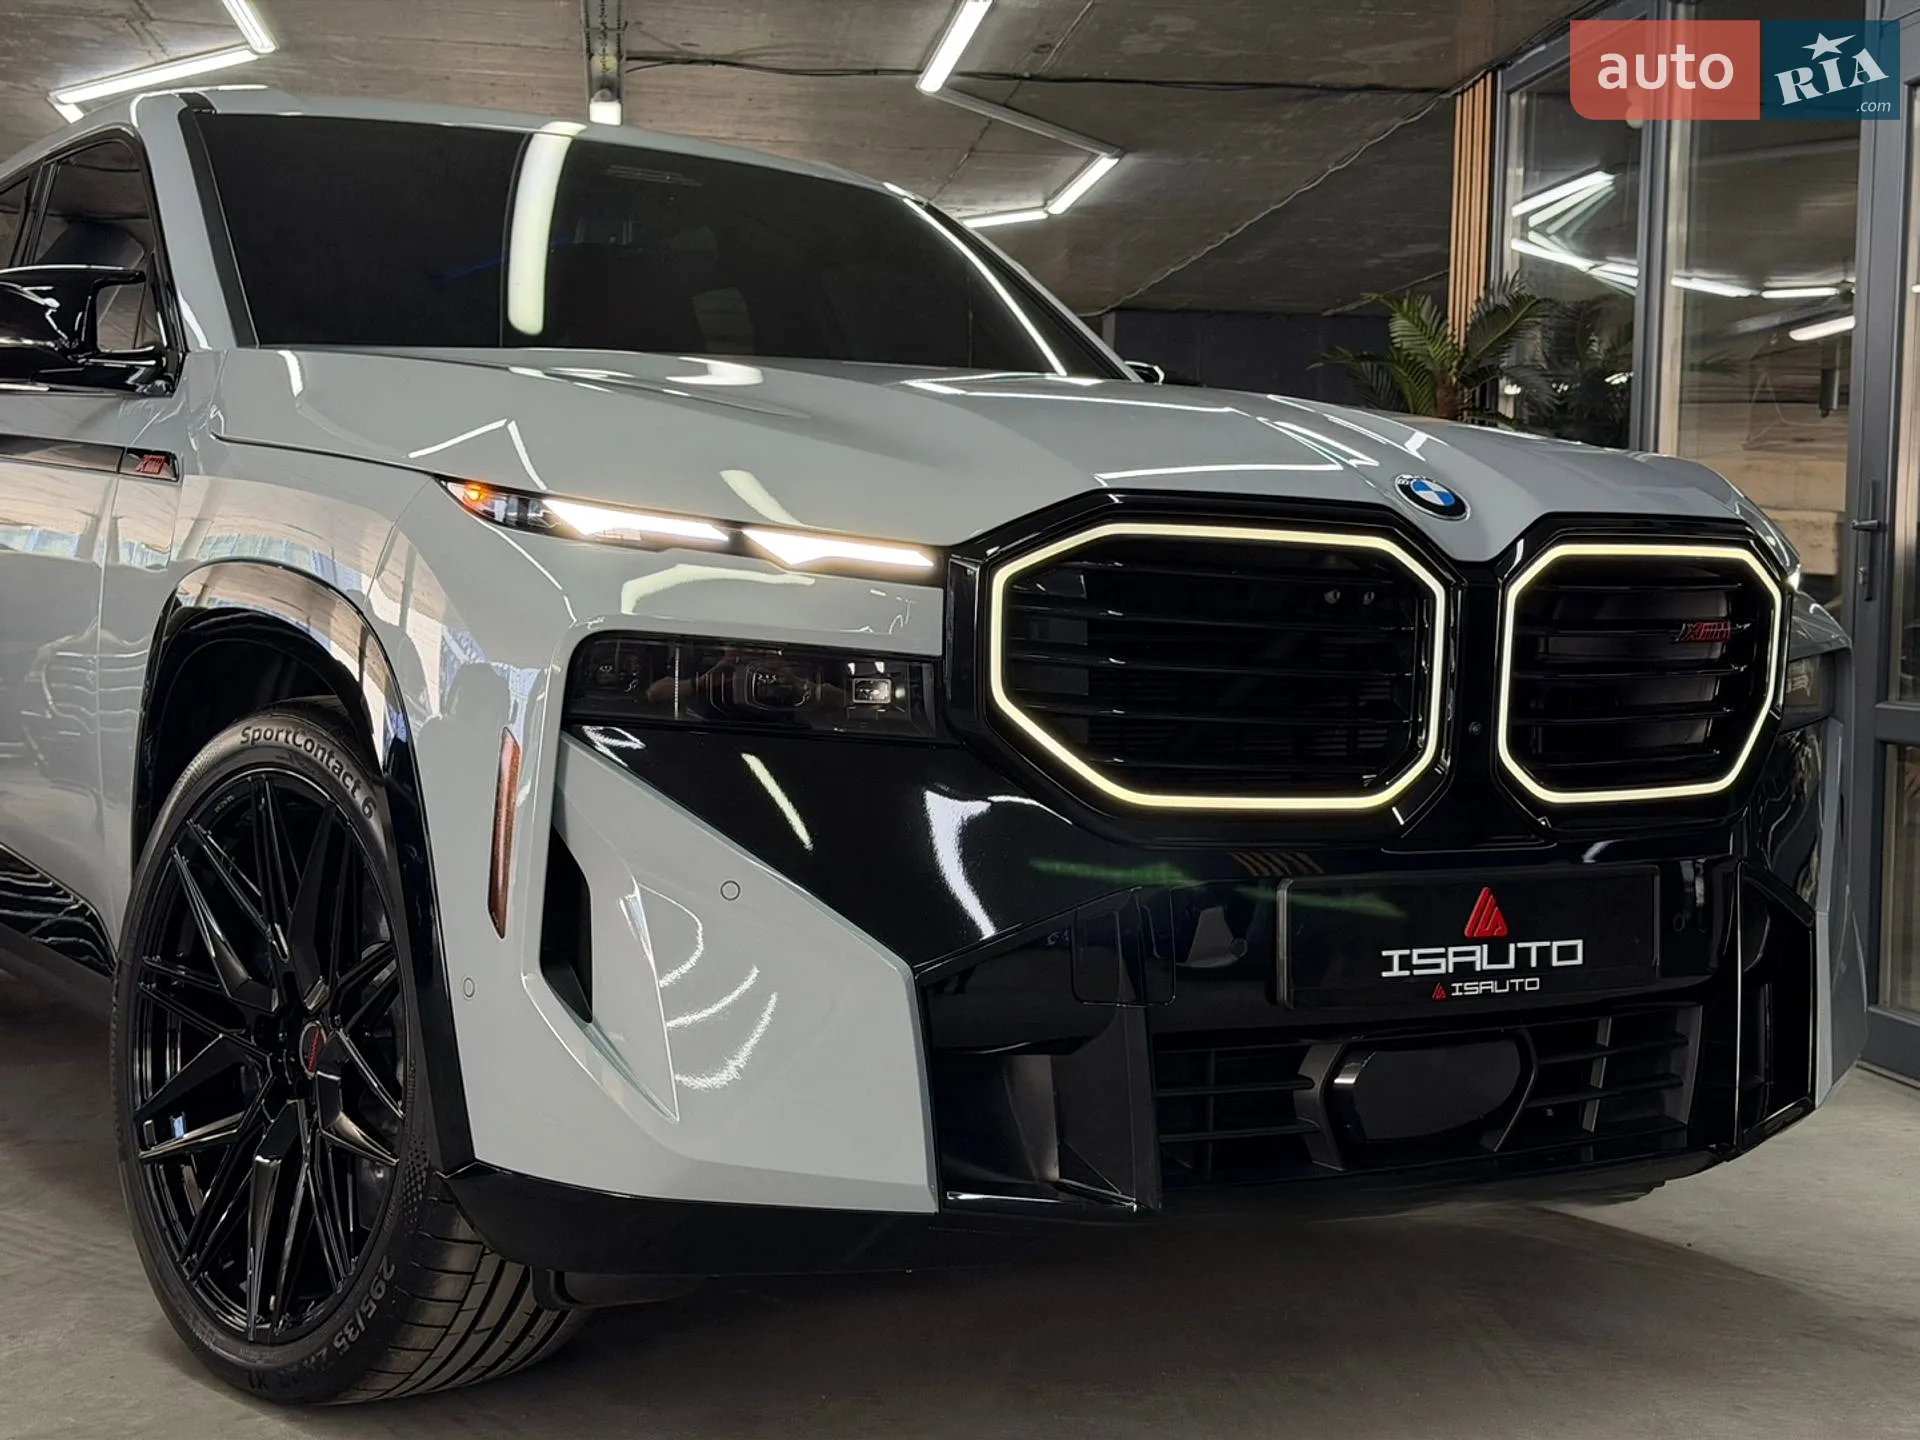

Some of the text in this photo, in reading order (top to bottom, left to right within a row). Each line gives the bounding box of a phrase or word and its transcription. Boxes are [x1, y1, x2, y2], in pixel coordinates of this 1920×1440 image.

[239, 726, 377, 819] SportContact 6
[1381, 938, 1584, 978] ISAUTO
[1450, 977, 1540, 997] ISAUTO
[332, 1255, 396, 1355] 295/35
